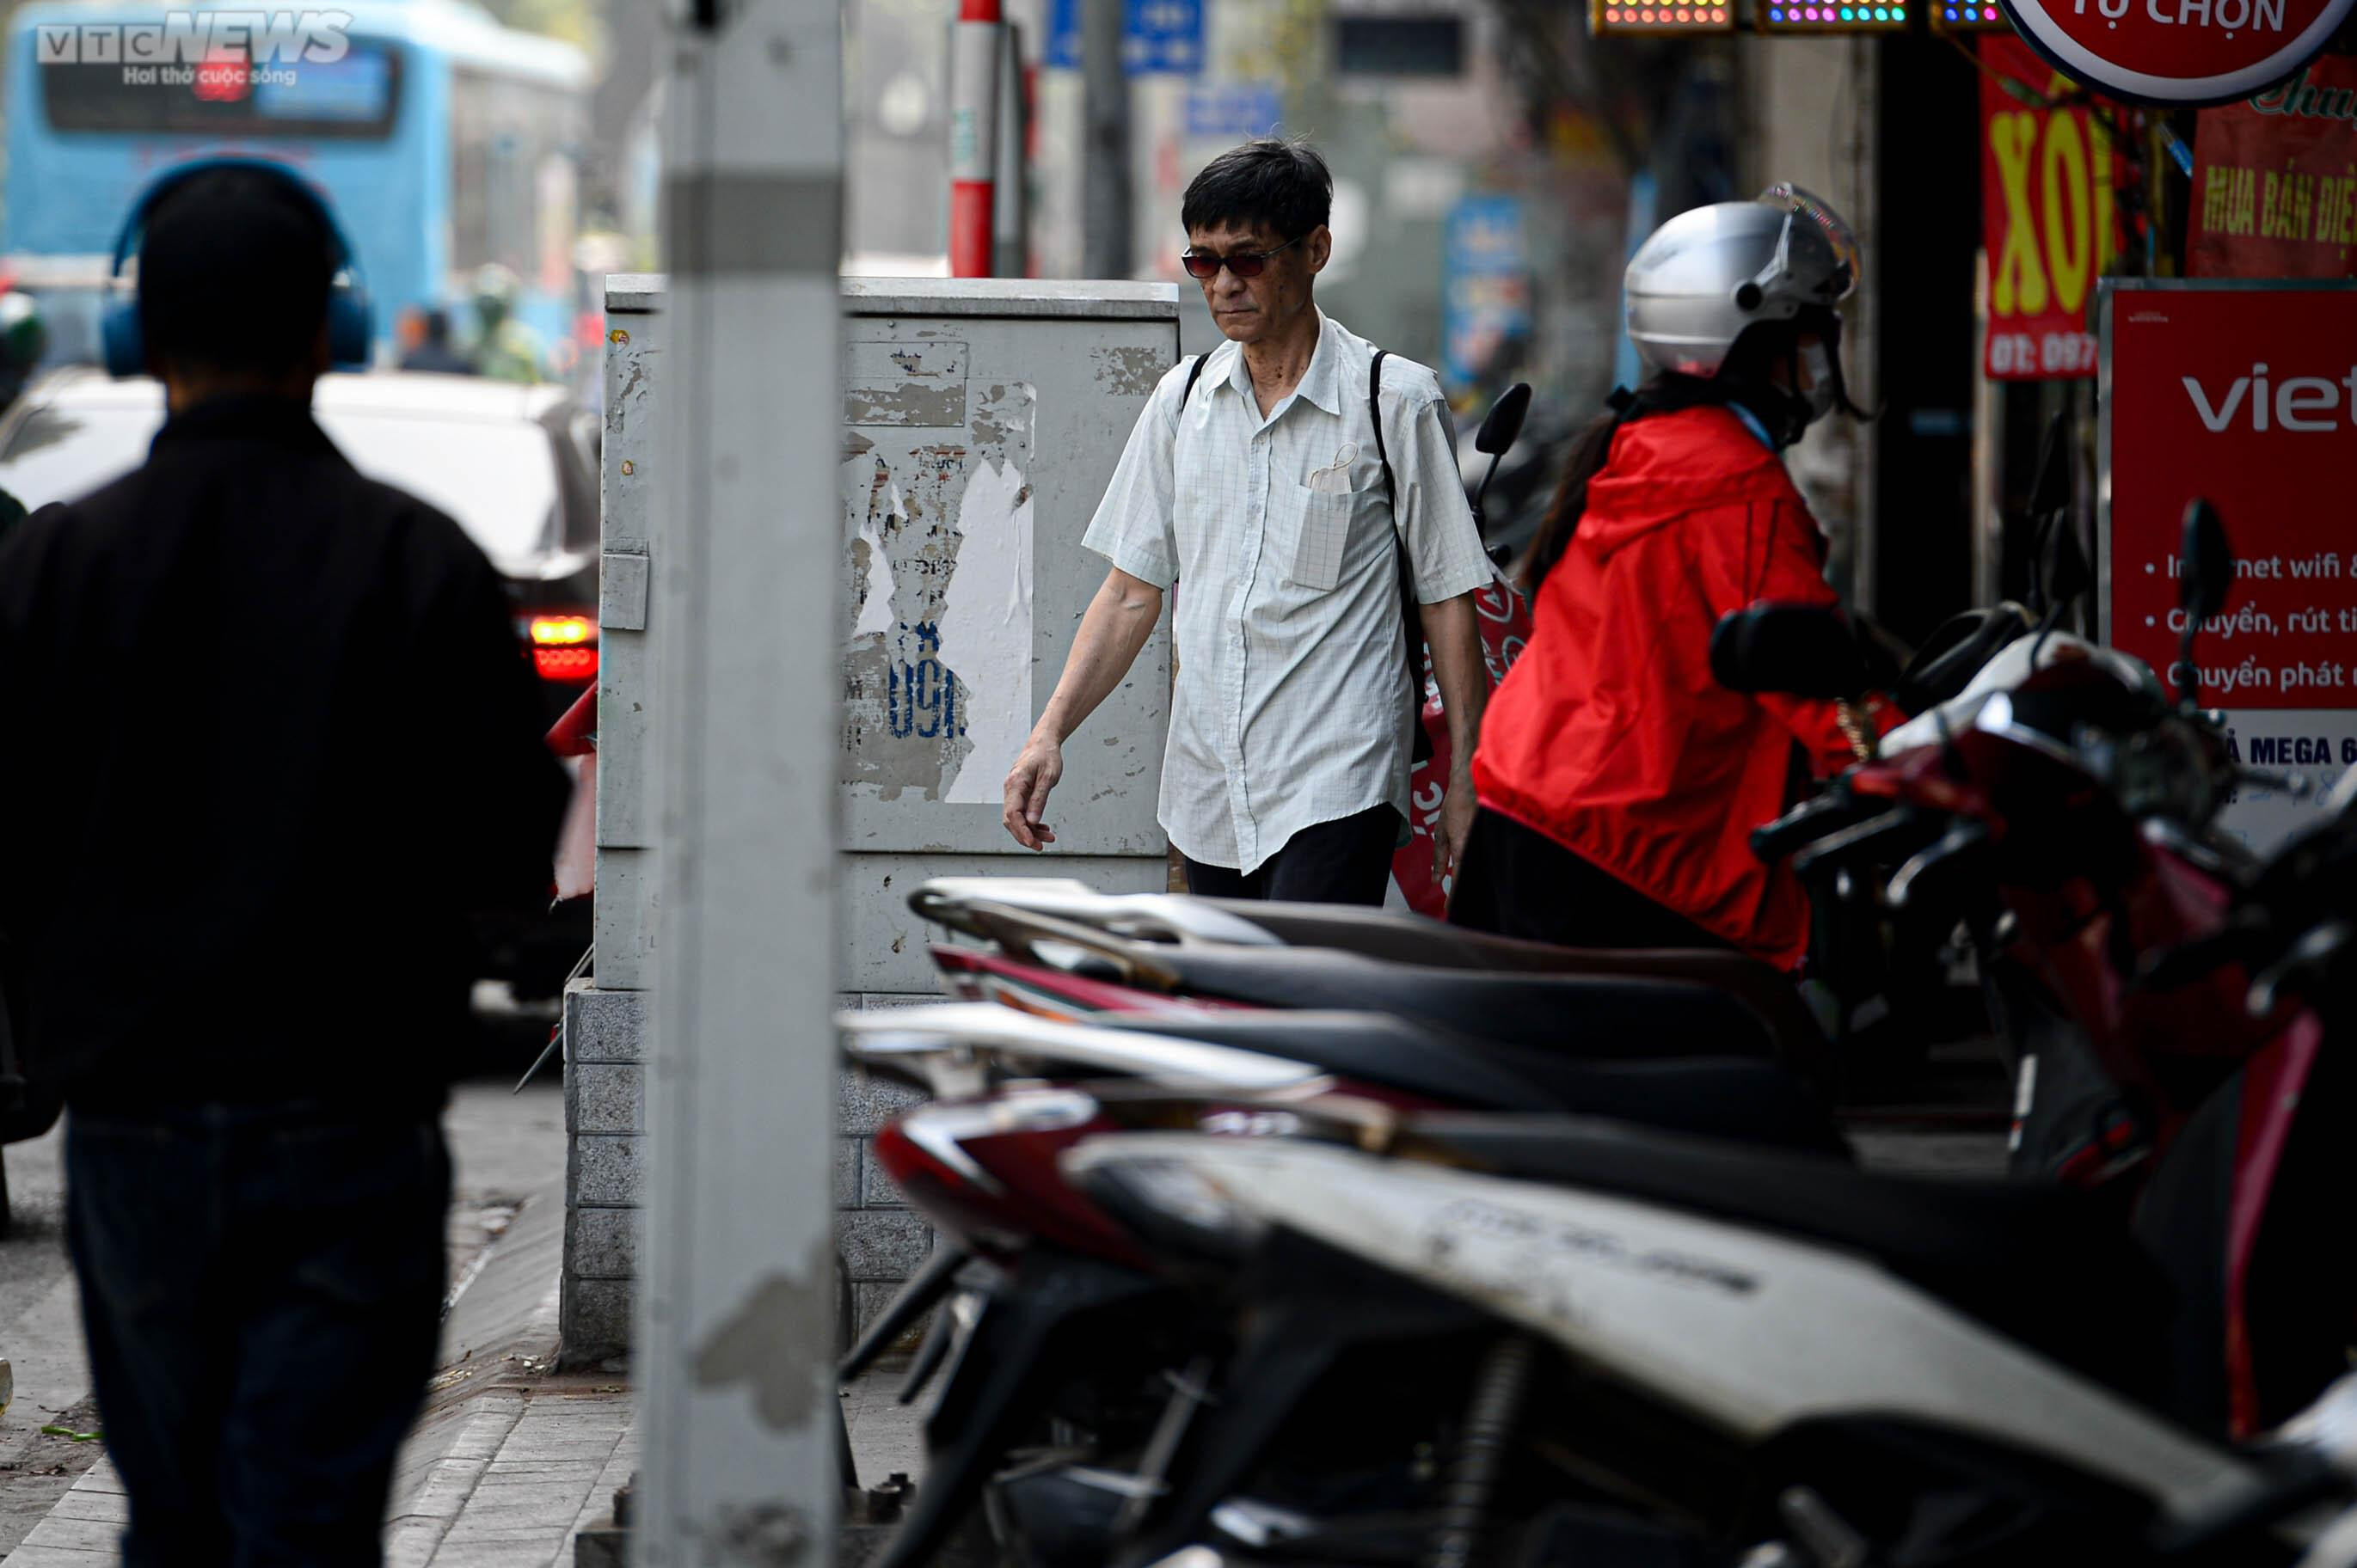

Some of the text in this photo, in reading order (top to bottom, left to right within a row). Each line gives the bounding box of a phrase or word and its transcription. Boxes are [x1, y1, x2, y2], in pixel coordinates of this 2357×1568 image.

[2202, 164, 2256, 236] MUA
[2261, 157, 2315, 242] BÁN
[2289, 552, 2342, 579] wifi
[2287, 606, 2332, 634] rút
[2280, 659, 2346, 695] phát
[2250, 737, 2332, 764] MEGA
